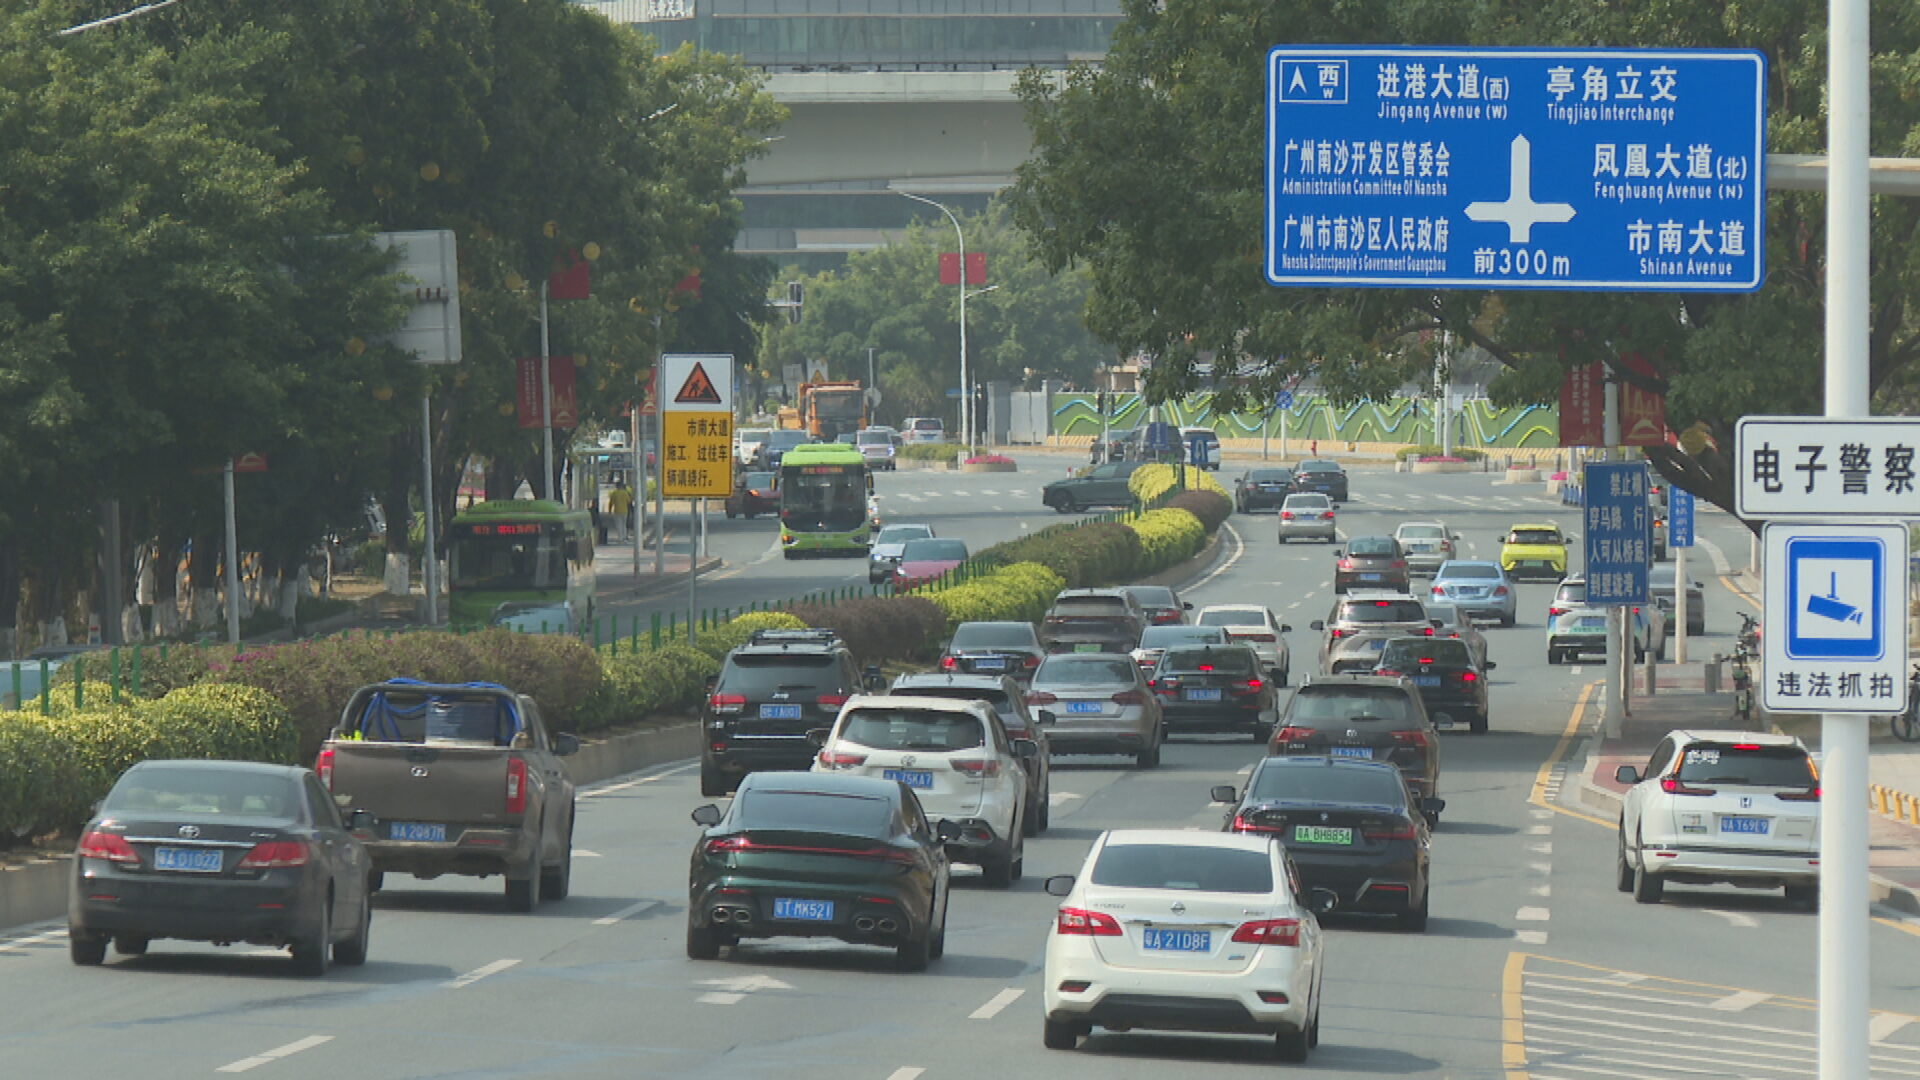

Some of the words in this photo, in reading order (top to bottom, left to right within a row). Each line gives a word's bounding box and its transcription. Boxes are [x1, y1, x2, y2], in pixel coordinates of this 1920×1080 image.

[1317, 64, 1340, 87] 西
[1547, 64, 1677, 102] 亭角立交
[1323, 88, 1333, 99] W
[1378, 102, 1430, 122] Jingang
[1434, 103, 1481, 119] Avenue
[1486, 104, 1508, 120] (W)
[1547, 104, 1597, 125] Tingjiao
[1601, 104, 1674, 126] Interchange
[1284, 138, 1450, 178] 广州南沙开发区管委会
[1283, 178, 1352, 195] Administration
[1354, 179, 1402, 196] Committee
[1404, 180, 1413, 196] Of
[1414, 180, 1447, 197] Nansha
[1595, 182, 1663, 203] Fenghuang
[1667, 182, 1712, 198] Avenue
[1719, 184, 1743, 199] (N)
[1283, 214, 1448, 253] 广州市南沙区人民政府
[1627, 218, 1745, 256] 市南大道
[1364, 254, 1406, 271] Government
[1407, 255, 1447, 276] Guangzhou
[1640, 258, 1684, 275] Shinan
[1687, 259, 1733, 275] Avenue
[687, 418, 728, 437] 市南大道
[1753, 442, 1915, 495] 电子警察
[1610, 472, 1643, 497] 禁止横
[1589, 538, 1645, 563] 人可从桥底
[1777, 671, 1893, 698] 违法抓拍
